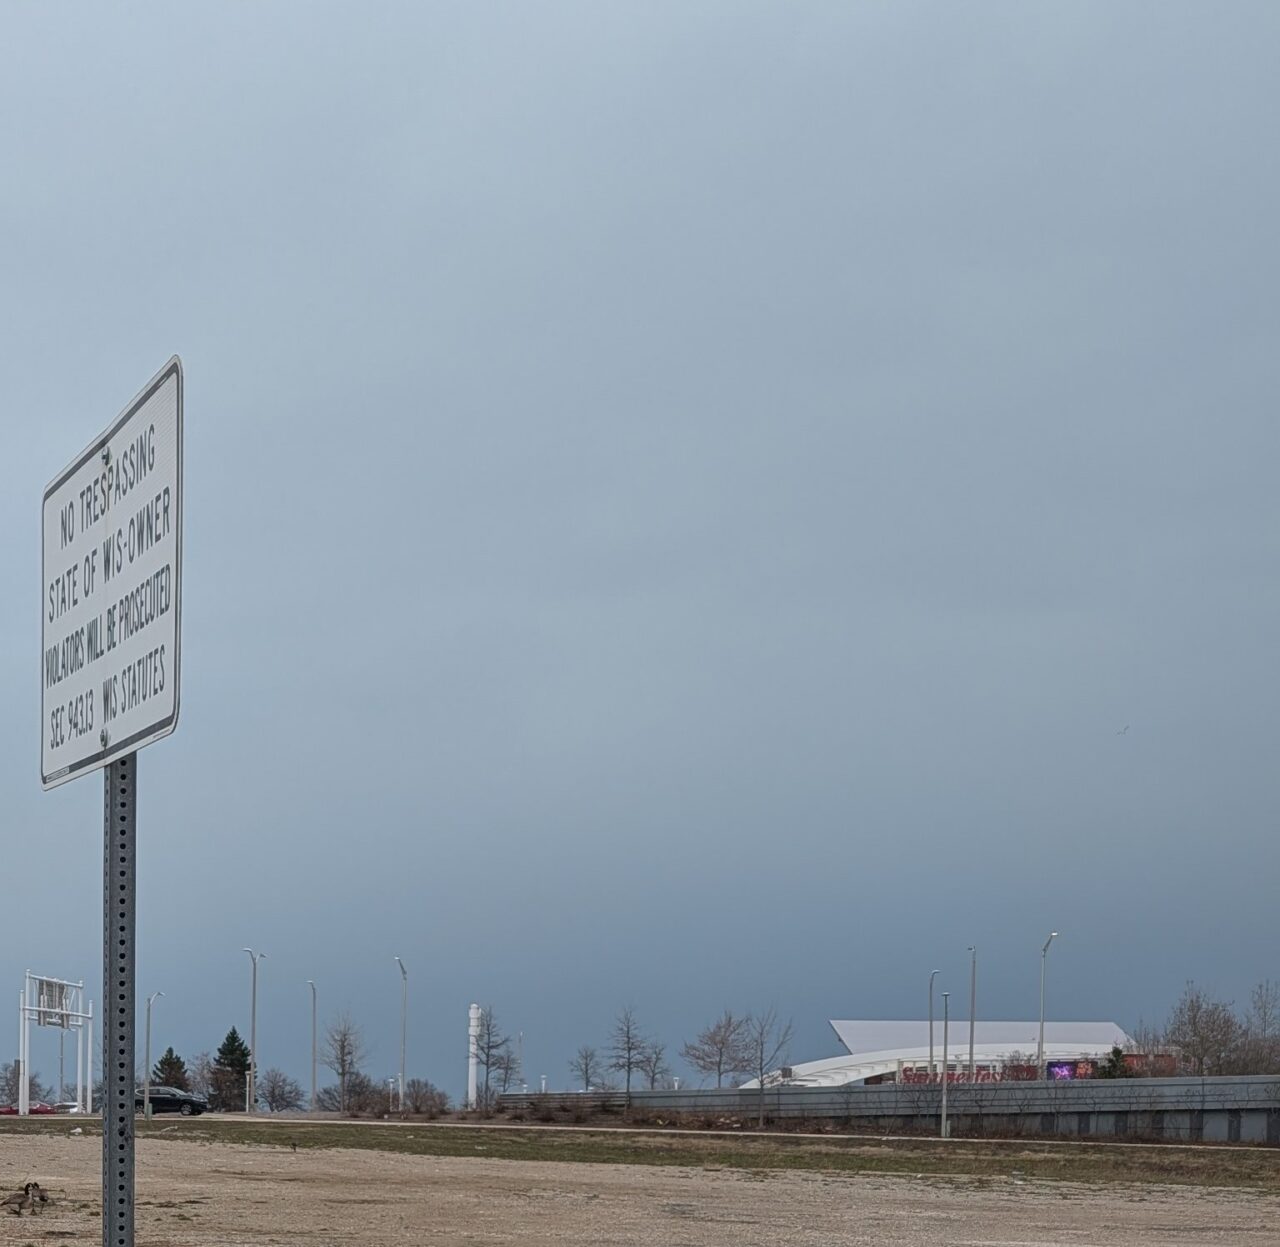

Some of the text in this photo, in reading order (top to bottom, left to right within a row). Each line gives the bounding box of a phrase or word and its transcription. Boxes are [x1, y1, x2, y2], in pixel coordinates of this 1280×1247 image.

[60, 424, 155, 550] NO TRESPASSING
[49, 486, 170, 623] STATE OF WIS-OWNER
[45, 563, 171, 689] VIOLATORS WILL BE PROSECUTED
[50, 644, 165, 750] SEC 943.13 WIS STATUTES
